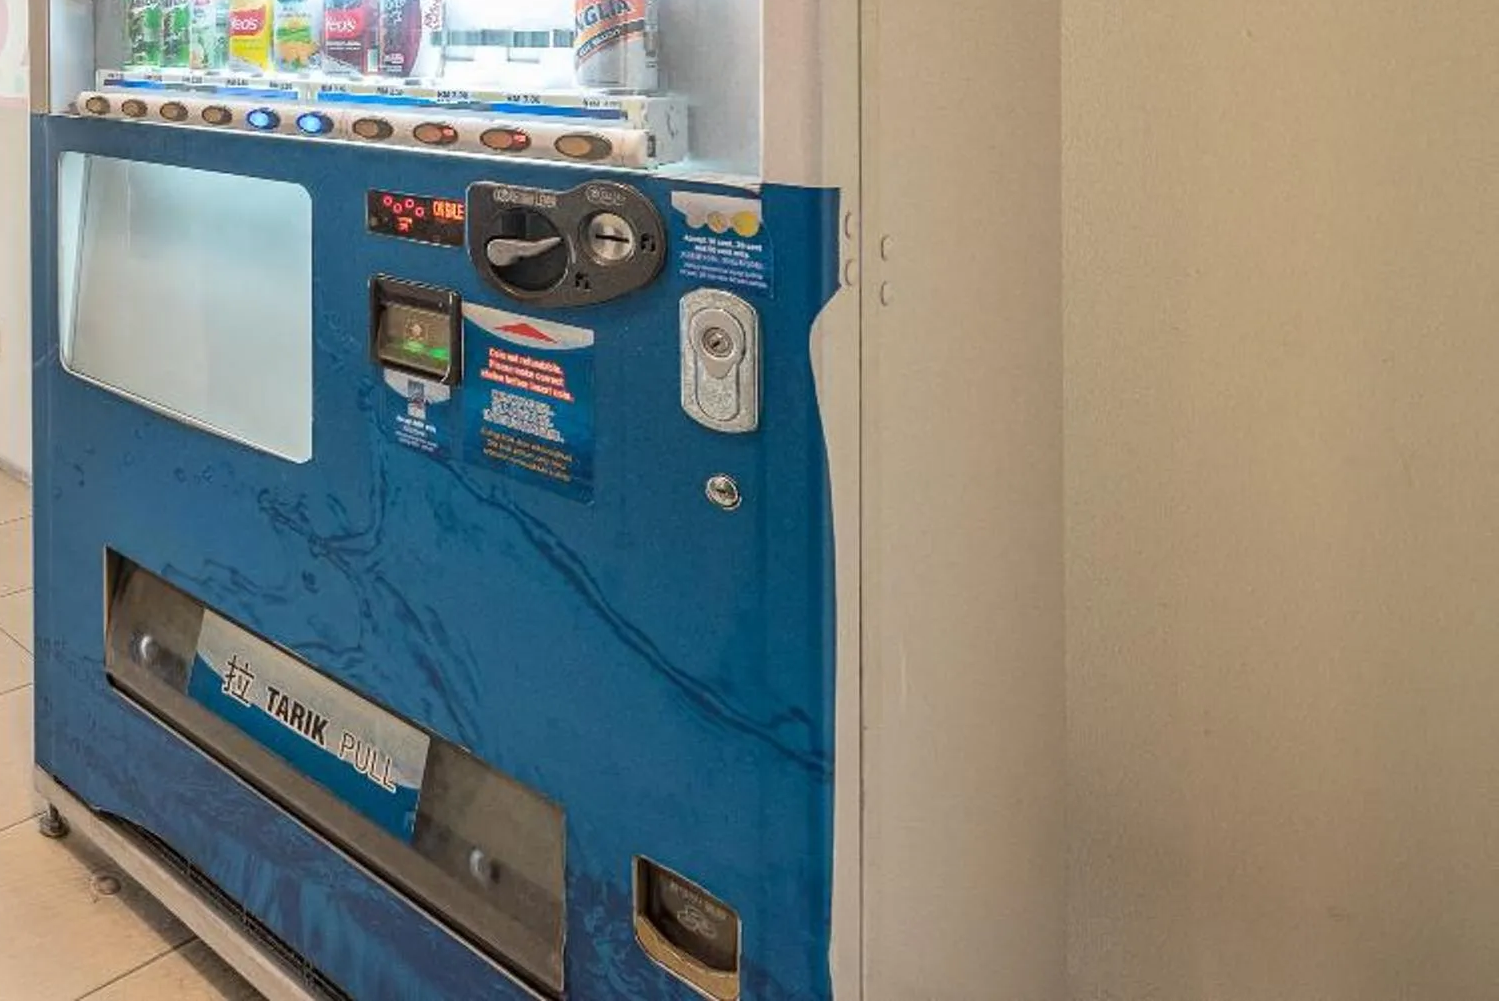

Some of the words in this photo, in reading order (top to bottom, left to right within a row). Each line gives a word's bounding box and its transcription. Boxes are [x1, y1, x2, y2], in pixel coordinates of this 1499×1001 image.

[222, 655, 255, 705] 拉
[267, 686, 329, 745] TARIK
[340, 730, 397, 792] PULL
